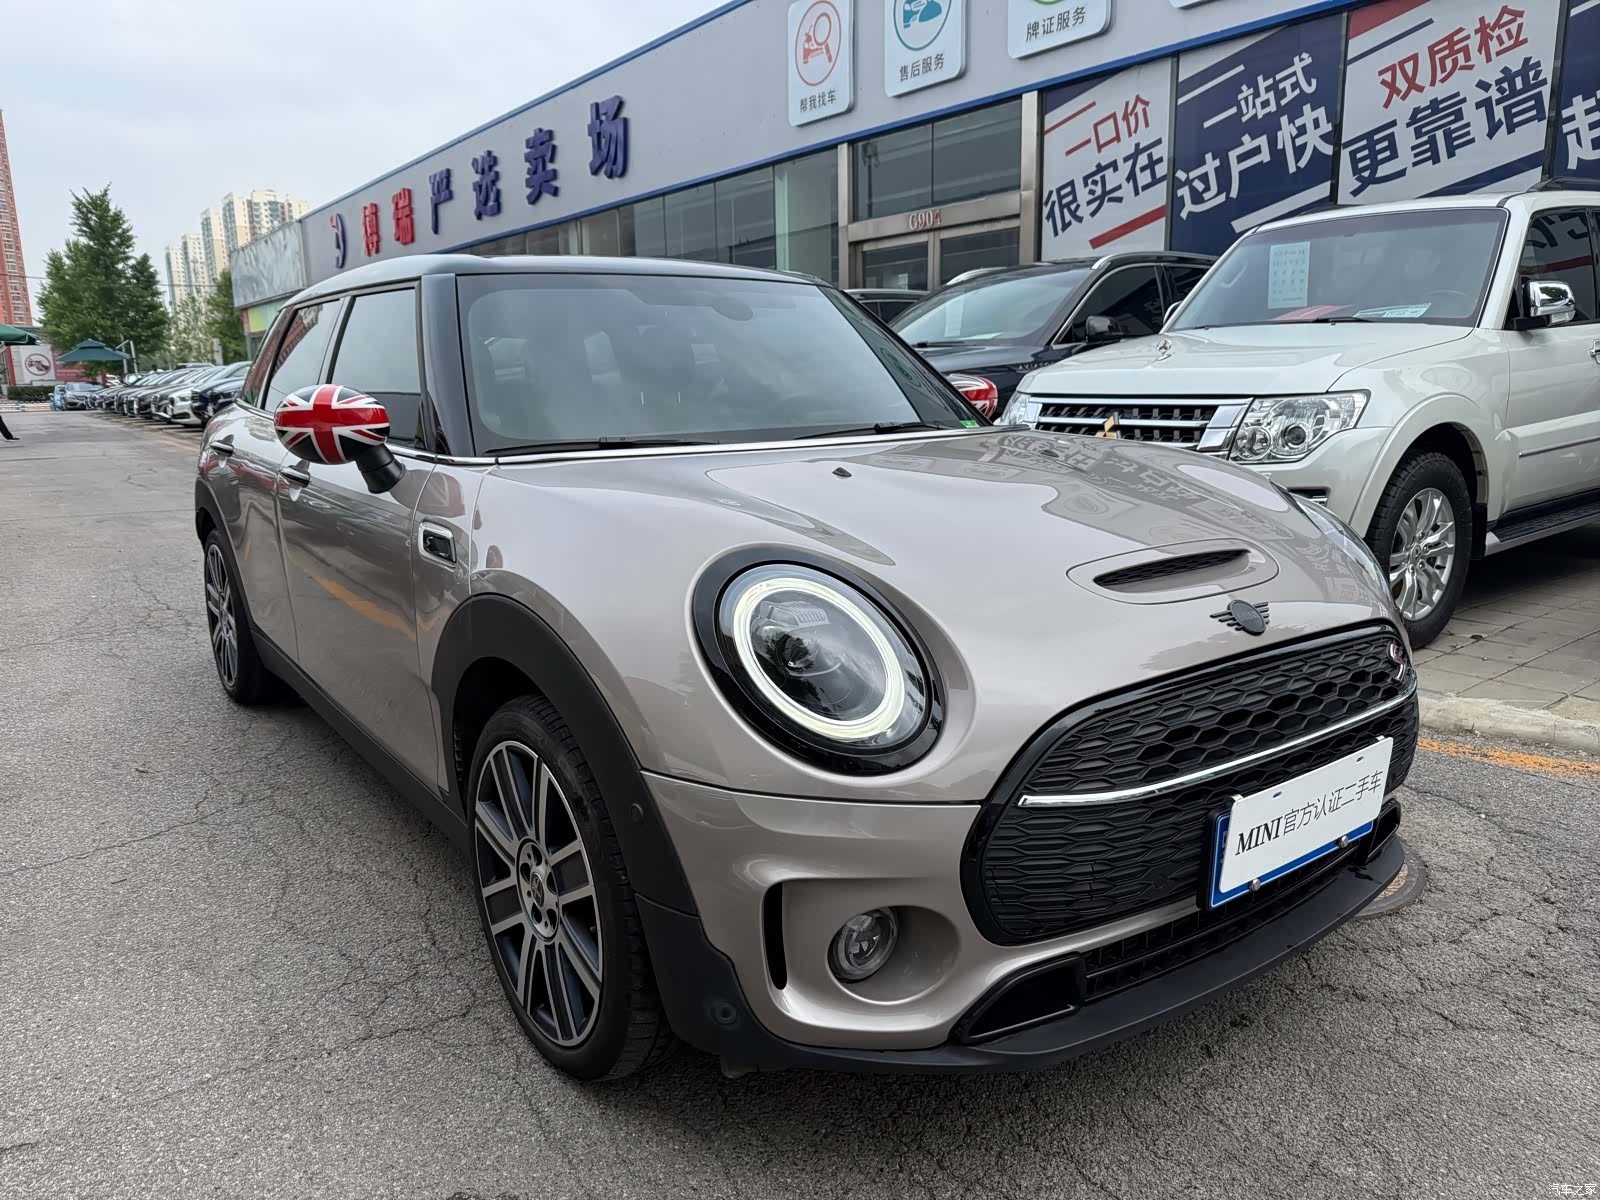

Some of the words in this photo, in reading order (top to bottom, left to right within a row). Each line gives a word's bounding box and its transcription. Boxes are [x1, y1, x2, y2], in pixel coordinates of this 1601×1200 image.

[1026, 5, 1087, 43] 牌证服务
[1378, 5, 1529, 109] 双质检
[799, 89, 837, 113] 帮我找车
[899, 53, 945, 83] 售后服务
[1203, 51, 1317, 128] 一站式
[1065, 94, 1150, 157] 一口价
[1344, 55, 1549, 197] 更靠谱
[1043, 137, 1168, 238] 很实在
[1174, 103, 1335, 221] 过户快
[908, 209, 942, 231] G904
